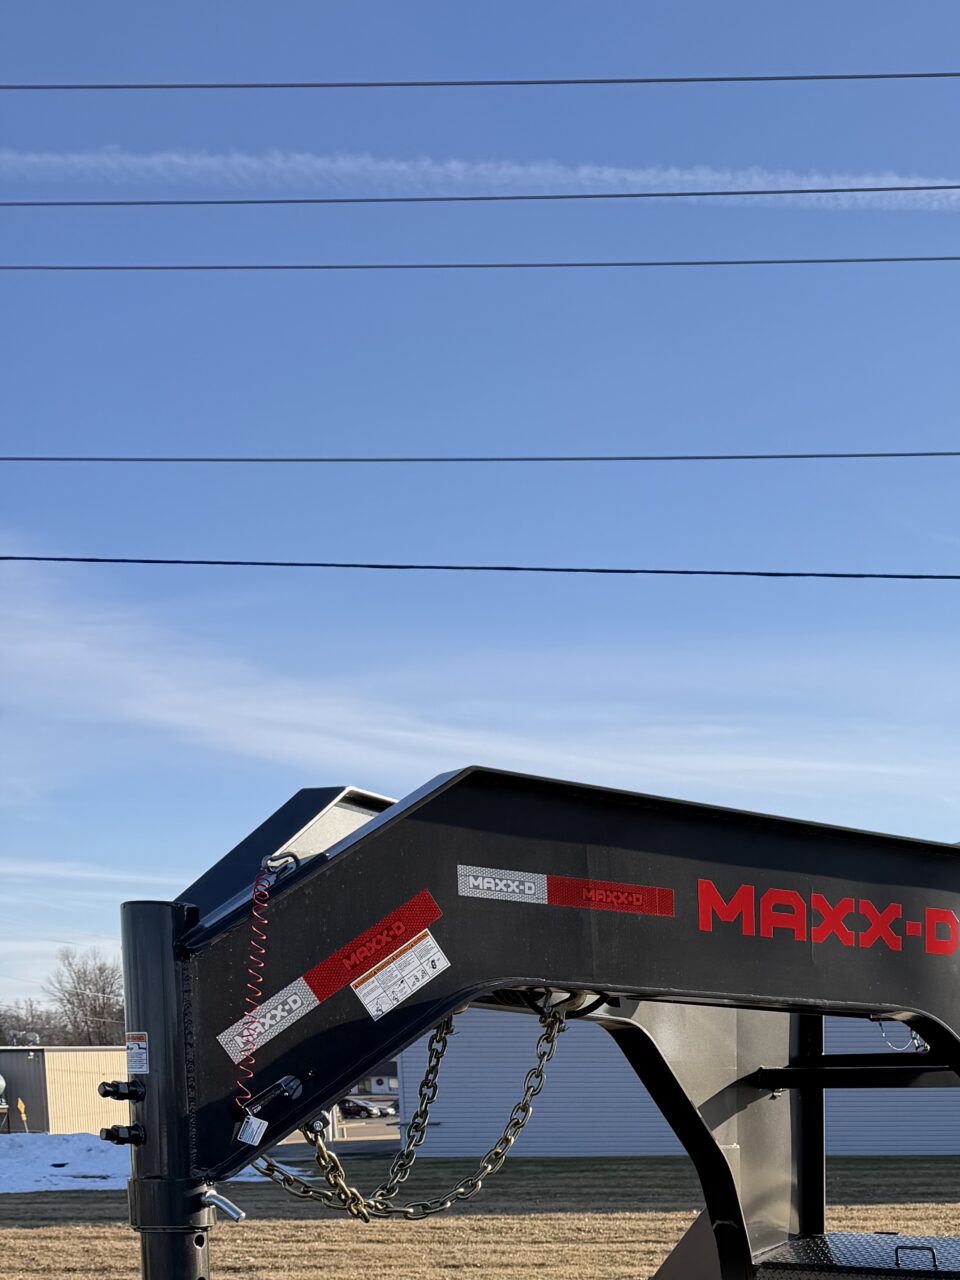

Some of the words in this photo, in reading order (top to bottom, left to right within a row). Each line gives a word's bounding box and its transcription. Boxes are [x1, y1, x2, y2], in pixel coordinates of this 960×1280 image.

[468, 875, 536, 895] MAXX-D
[582, 887, 643, 906] MAXX-D
[697, 878, 960, 956] MAXX-D
[341, 920, 406, 970] MAXX-D
[233, 994, 303, 1051] MAXX-D
